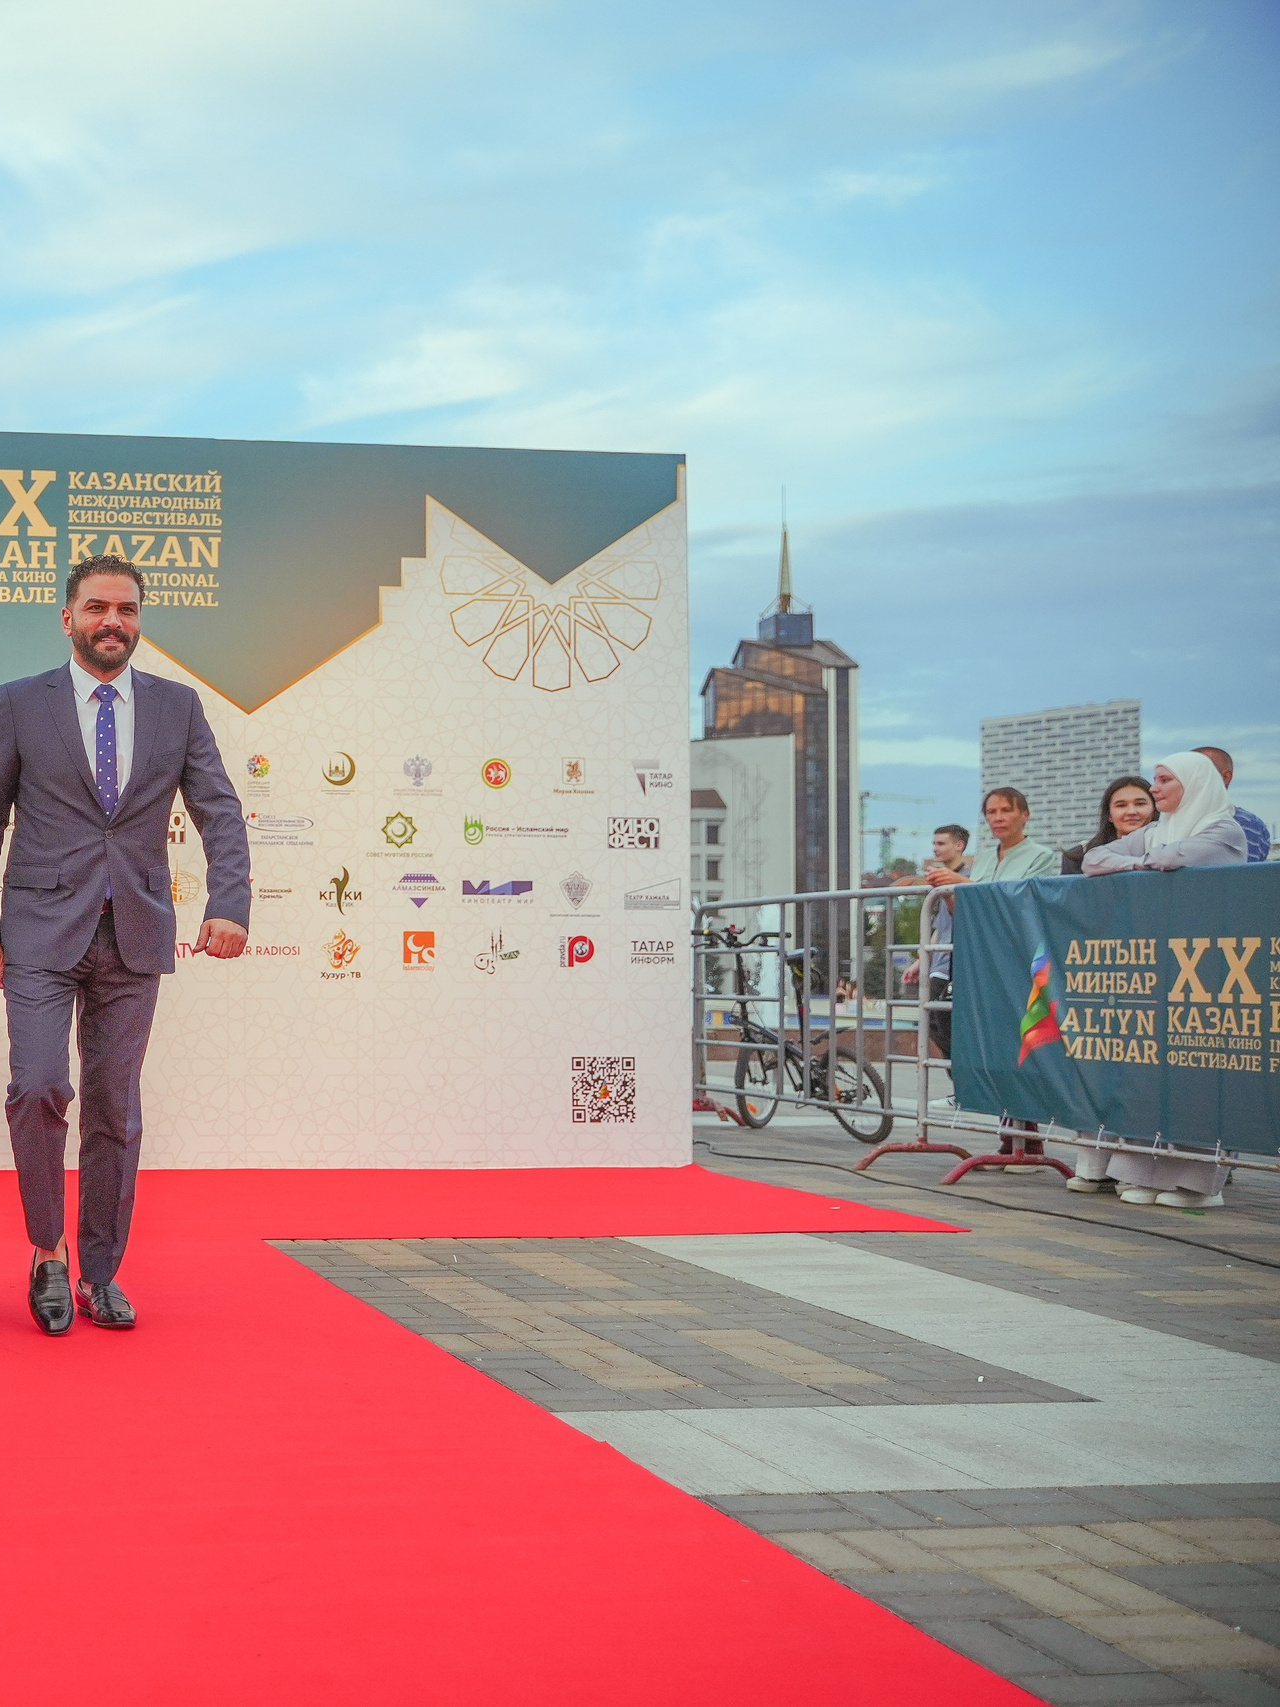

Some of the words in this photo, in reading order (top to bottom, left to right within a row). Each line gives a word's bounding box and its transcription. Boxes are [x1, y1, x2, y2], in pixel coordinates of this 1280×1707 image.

[68, 469, 222, 493] КАЗАНСКИЙ
[68, 494, 222, 511] МЕЖДУНАРОДНЫЙ
[68, 510, 223, 527] КИНОФЕСТИВАЛЬ
[68, 534, 222, 568] KAZAN
[12, 571, 57, 584] КИНО
[143, 591, 219, 607] ESTIVAL
[609, 818, 659, 834] КИНО
[609, 834, 658, 849] ФЕСТ
[256, 946, 300, 956] RADIOSI
[558, 936, 566, 967] pravda.ru
[631, 941, 674, 952] ТАТАР
[1065, 939, 1157, 965] АЛТЫН
[631, 956, 674, 964] ИНФОРМ
[1065, 971, 1157, 995] МИНБАР
[1059, 1007, 1155, 1036] ALTYN
[1167, 1006, 1262, 1037] КАЗАН
[1061, 1035, 1159, 1065] MINBAR
[1167, 1034, 1225, 1048] ХАЛЫКАРА
[1228, 1037, 1262, 1050] КИНО
[1167, 1051, 1262, 1072] ФЕСТИВАЛЕ
